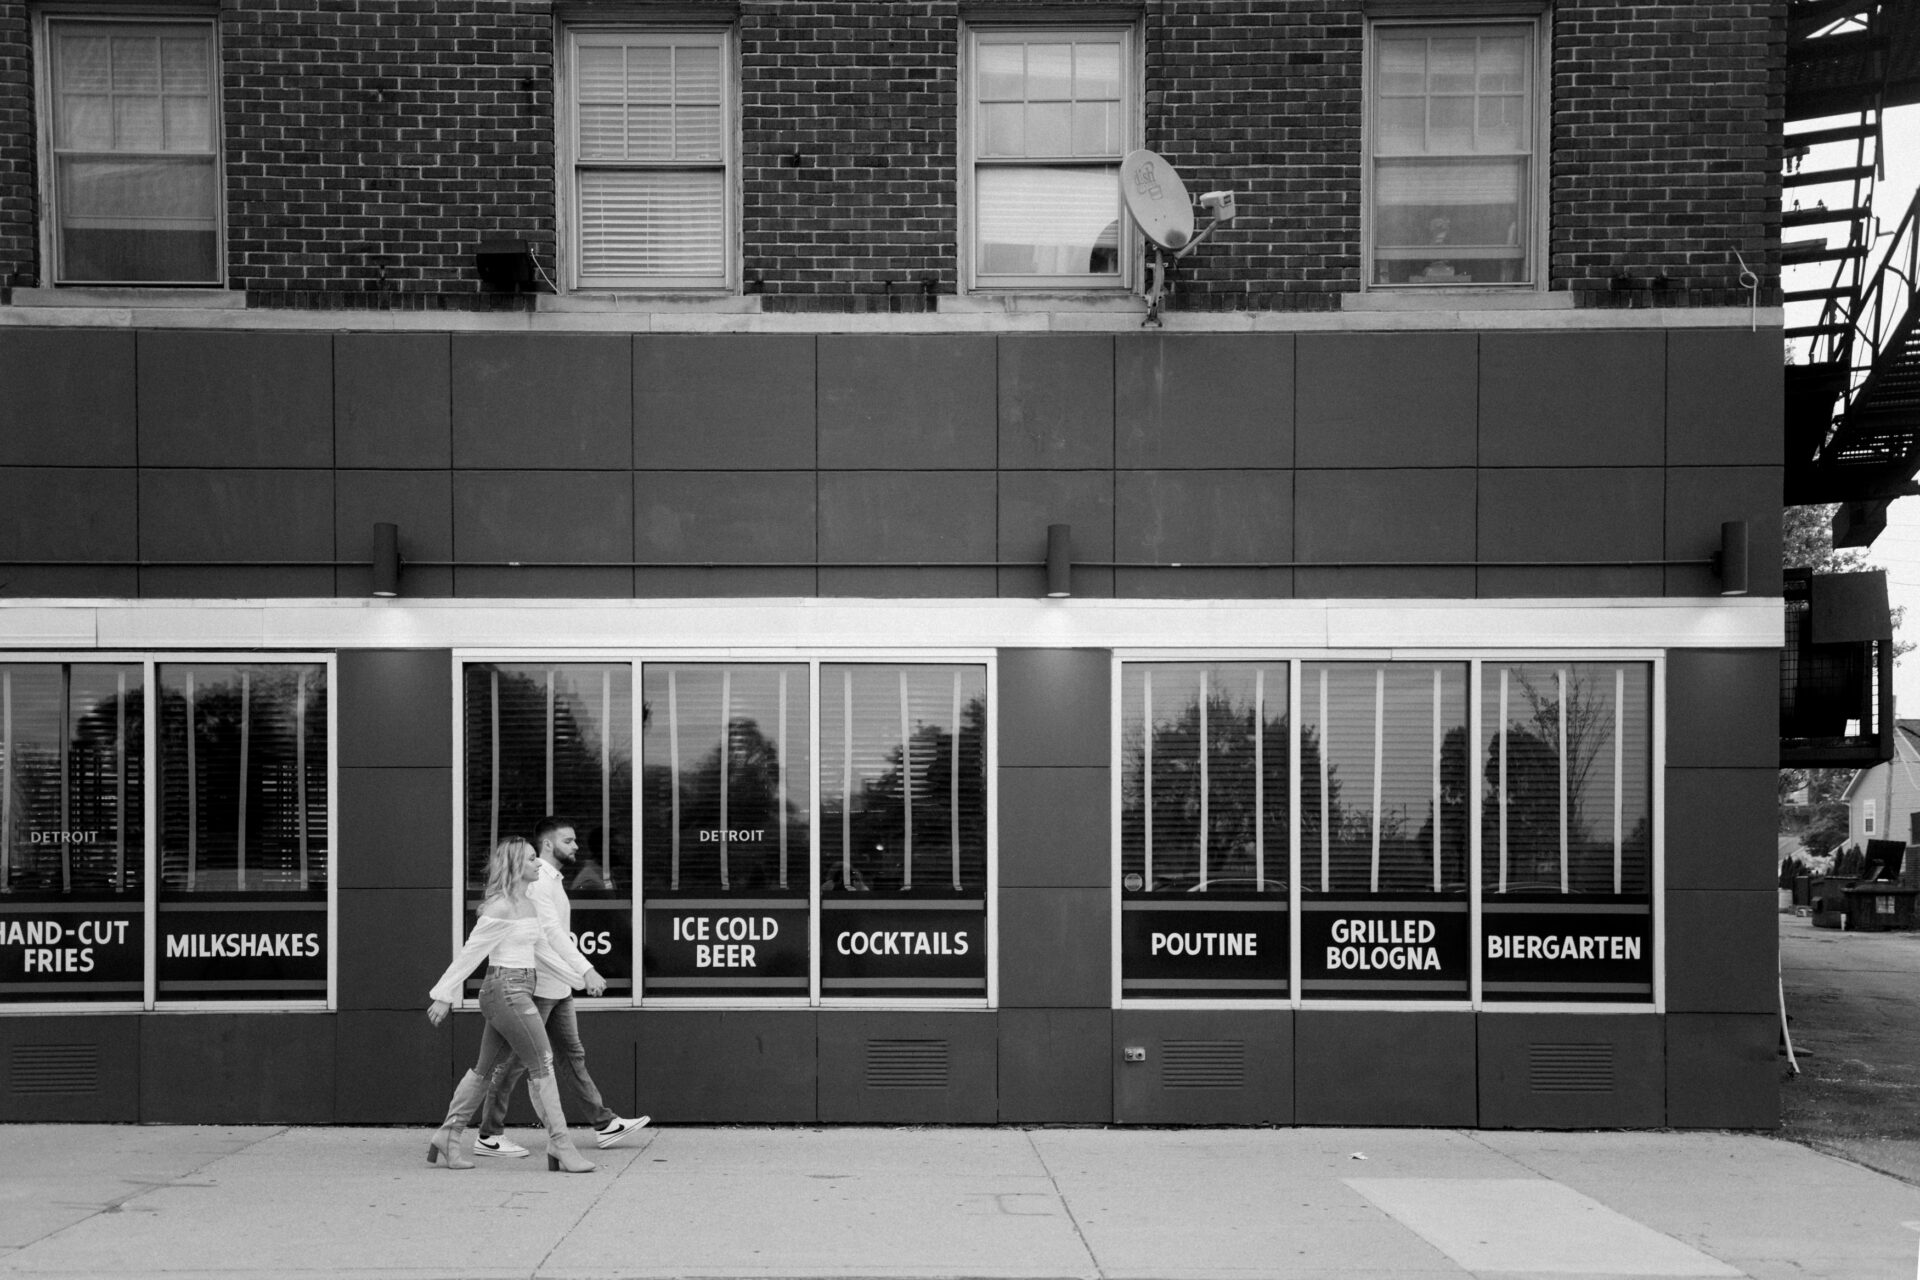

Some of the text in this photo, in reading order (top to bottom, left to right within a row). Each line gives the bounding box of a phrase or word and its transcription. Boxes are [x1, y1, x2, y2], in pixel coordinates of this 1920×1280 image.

[31, 831, 98, 843] DETROIT
[699, 830, 765, 841] DETROIT
[673, 916, 778, 941] ICE COLD
[1331, 918, 1435, 943] GRILLED
[166, 932, 320, 958] MILKSHAKES
[836, 931, 969, 955] COCKTAILS
[1151, 932, 1257, 956] POUTINE
[1488, 935, 1641, 960] BIERGARTEN
[24, 948, 95, 973] FRIES
[696, 944, 757, 968] BEER
[1326, 945, 1441, 970] BOLOGNA
